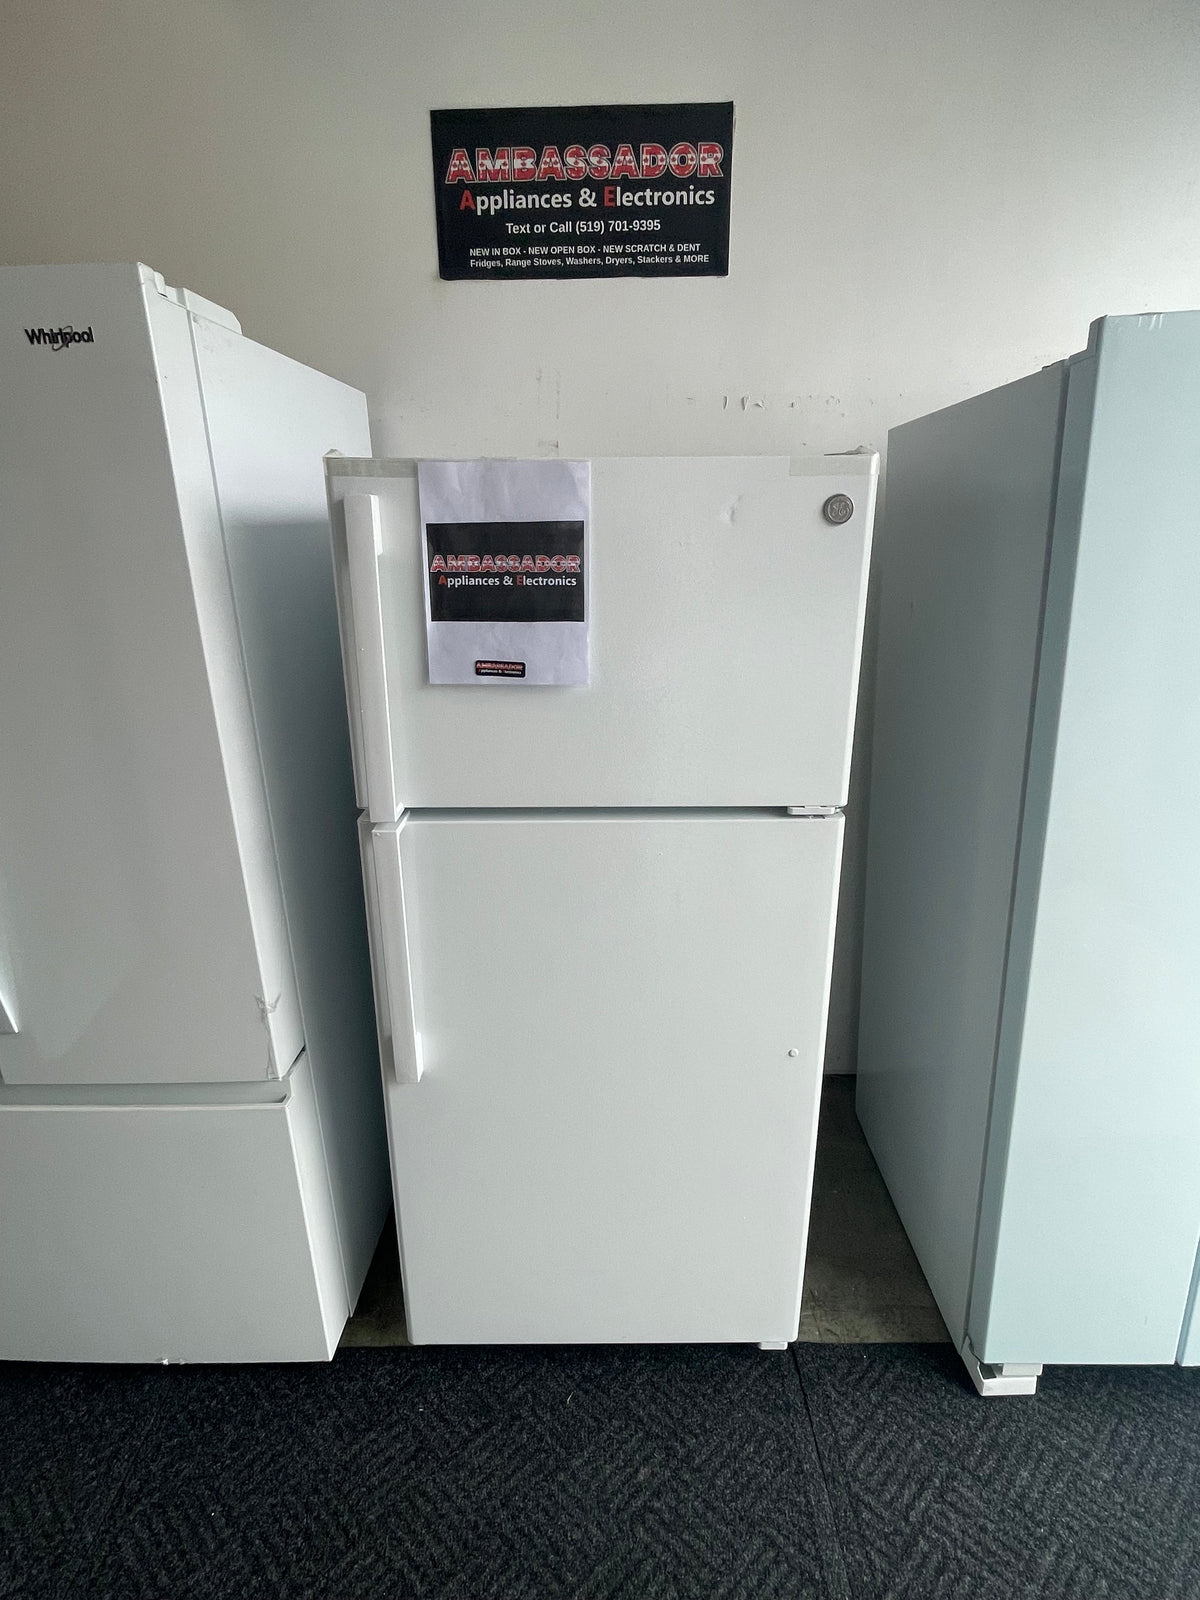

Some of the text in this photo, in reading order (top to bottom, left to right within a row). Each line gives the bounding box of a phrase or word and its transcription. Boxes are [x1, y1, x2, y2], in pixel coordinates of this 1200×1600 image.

[445, 142, 725, 184] AMBASSADOR
[459, 185, 715, 215] Appliances & Electronics
[505, 219, 661, 235] Text or Call (519) 701-9395
[469, 248, 490, 256] NEW
[491, 248, 501, 256] IN
[502, 247, 521, 256] BOX
[528, 246, 549, 255] NEW
[550, 246, 575, 254] OPEN
[577, 245, 596, 254] BOX
[602, 245, 624, 253] NEW
[625, 244, 667, 253] SCRATCH
[668, 244, 675, 252] &
[677, 243, 701, 252] DENT
[470, 254, 710, 269] Fridges, Range Stoves, Washers, Dryers, Stackers & MORE
[24, 326, 94, 349] Whirlpool
[430, 554, 581, 573] AMBASSADOR
[438, 574, 577, 588] Appliances & Electronics
